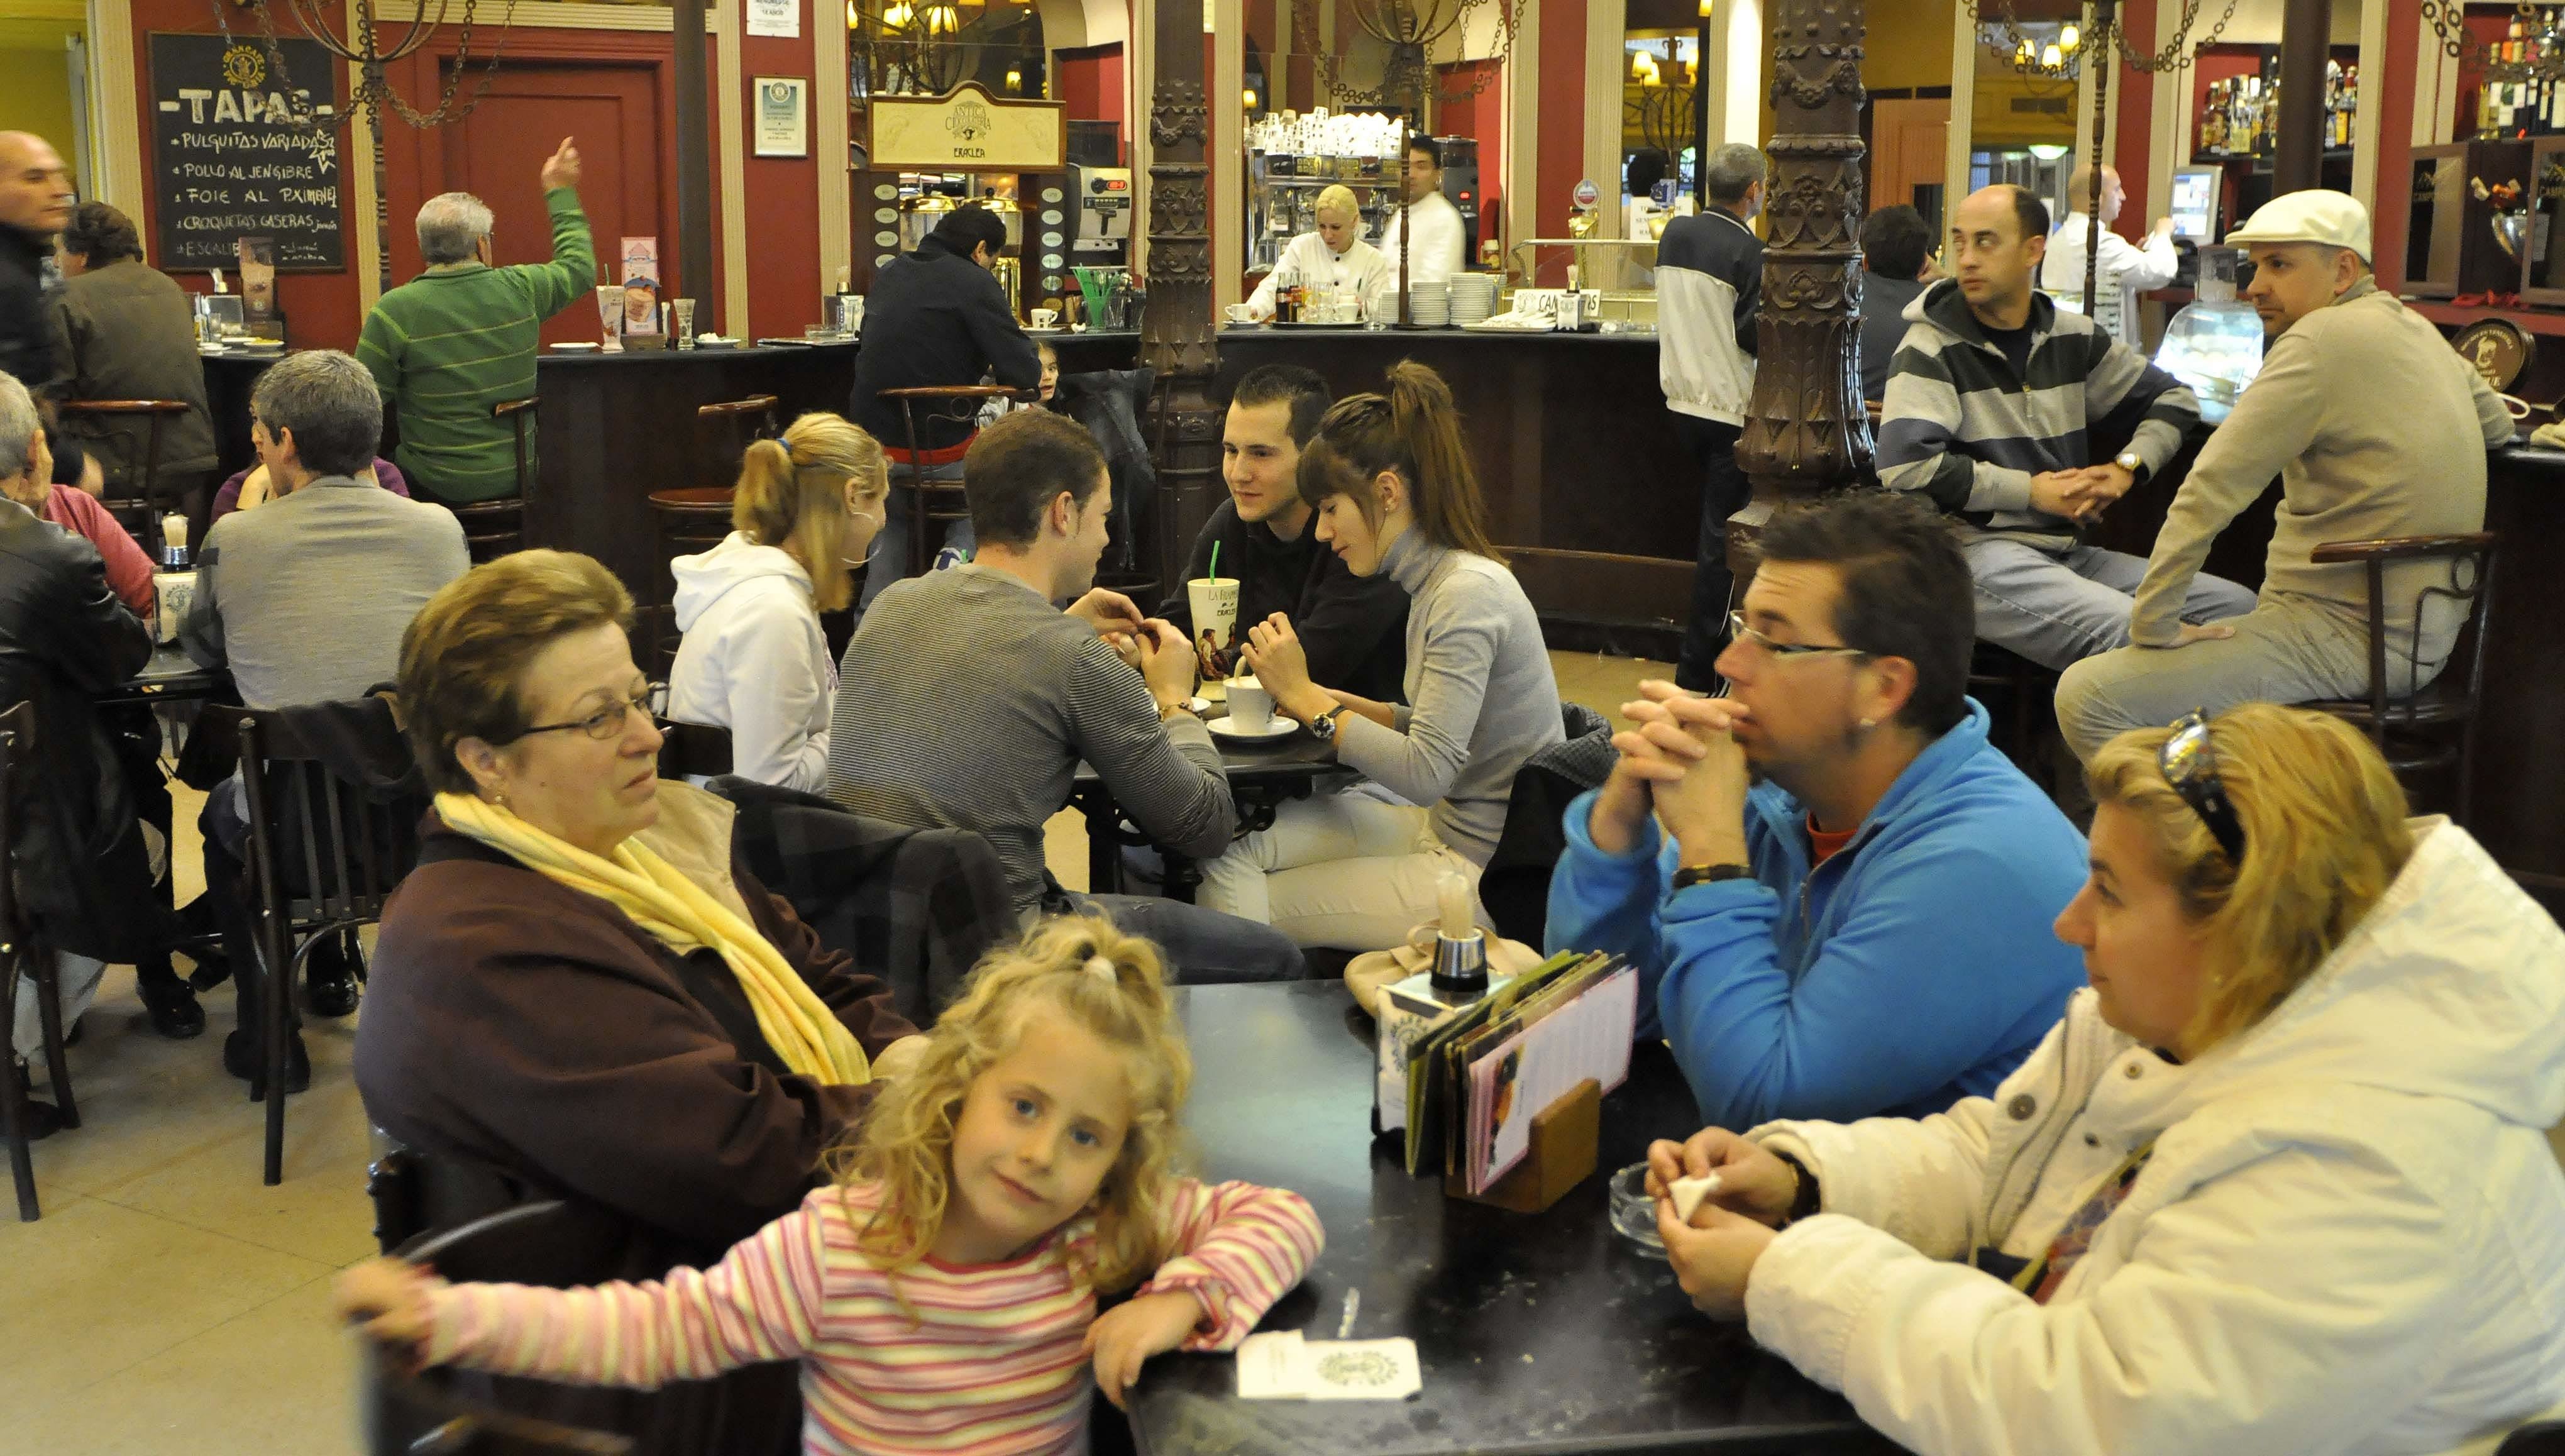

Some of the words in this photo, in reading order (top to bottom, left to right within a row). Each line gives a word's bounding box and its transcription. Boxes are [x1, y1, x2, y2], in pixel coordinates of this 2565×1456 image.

[181, 131, 258, 155] PULGUITAS
[954, 147, 985, 158] ERACLEA
[184, 162, 225, 178] POLLO
[228, 165, 246, 180] AL
[248, 163, 314, 181] JENGIBRE
[186, 188, 231, 204] FOIE
[245, 189, 270, 203] AL
[183, 214, 256, 231] CROQUETAS
[260, 213, 314, 229] CASERAS
